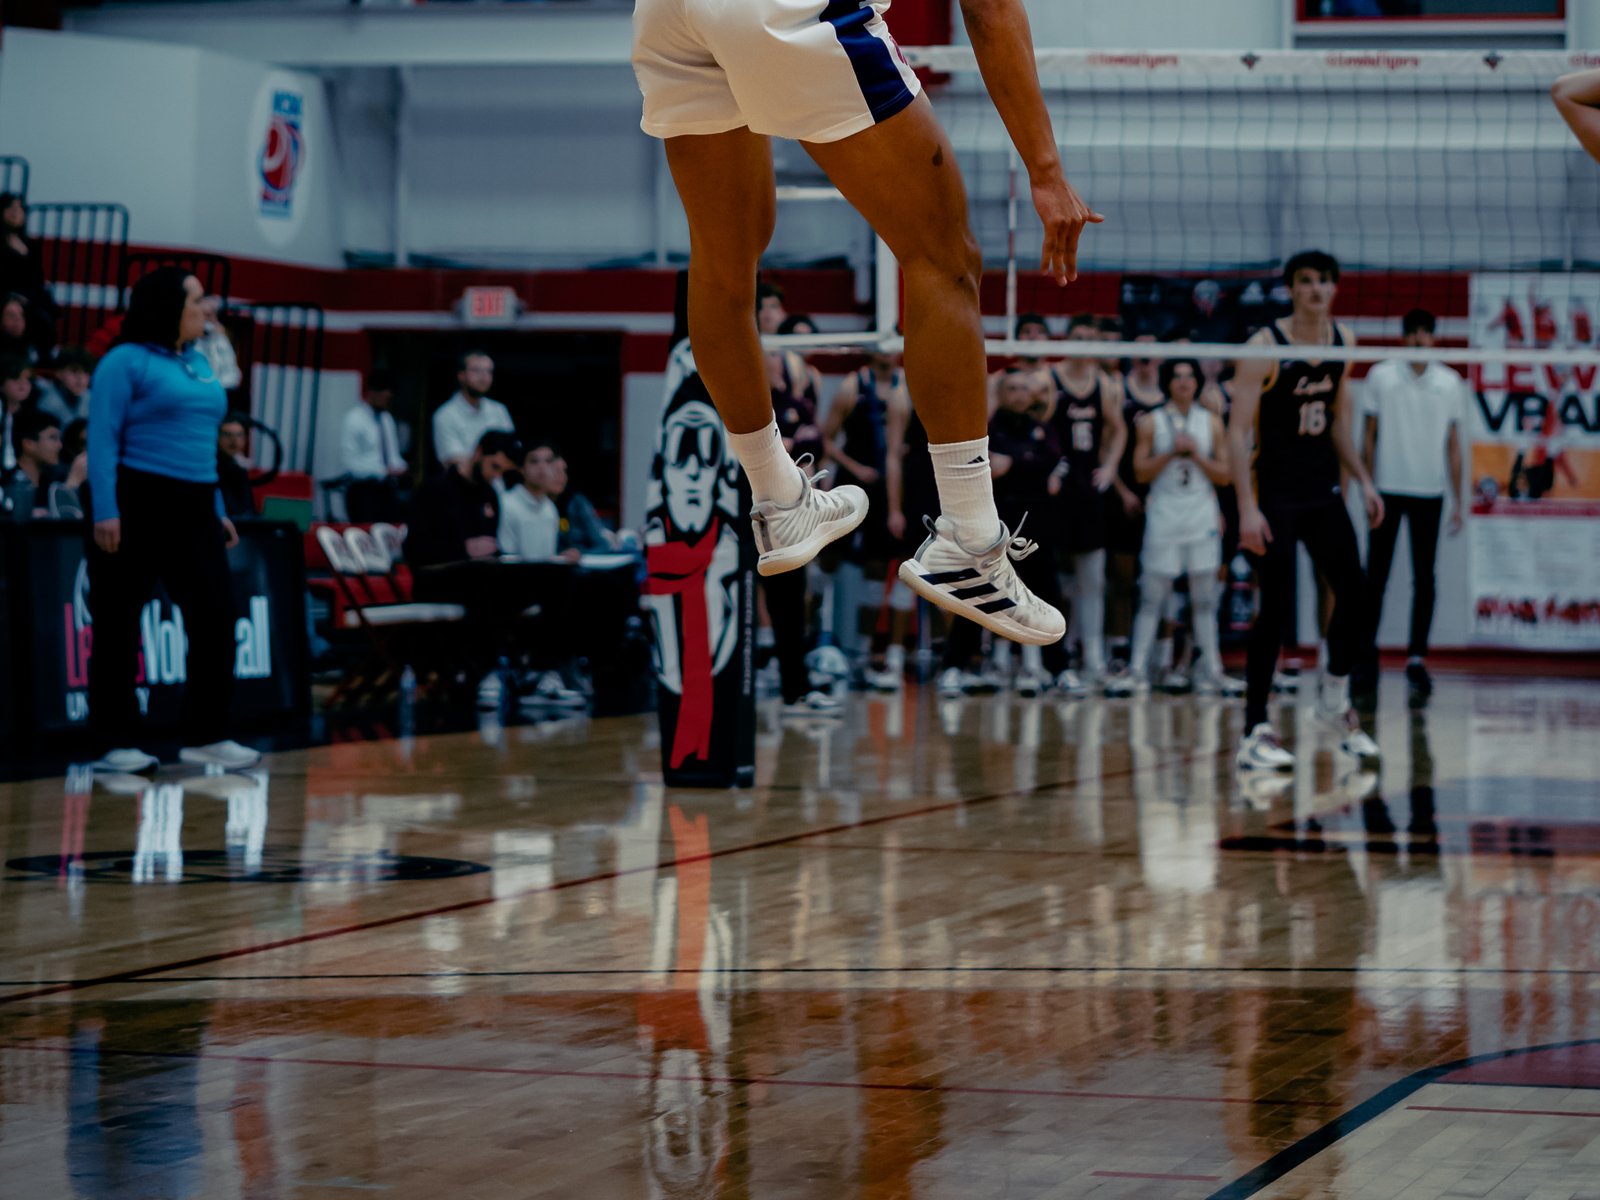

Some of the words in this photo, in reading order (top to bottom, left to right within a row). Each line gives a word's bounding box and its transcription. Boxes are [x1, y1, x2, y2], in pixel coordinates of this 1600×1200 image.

[472, 291, 505, 317] EXIT
[1473, 360, 1598, 393] LEW
[1475, 393, 1600, 433] VBA
